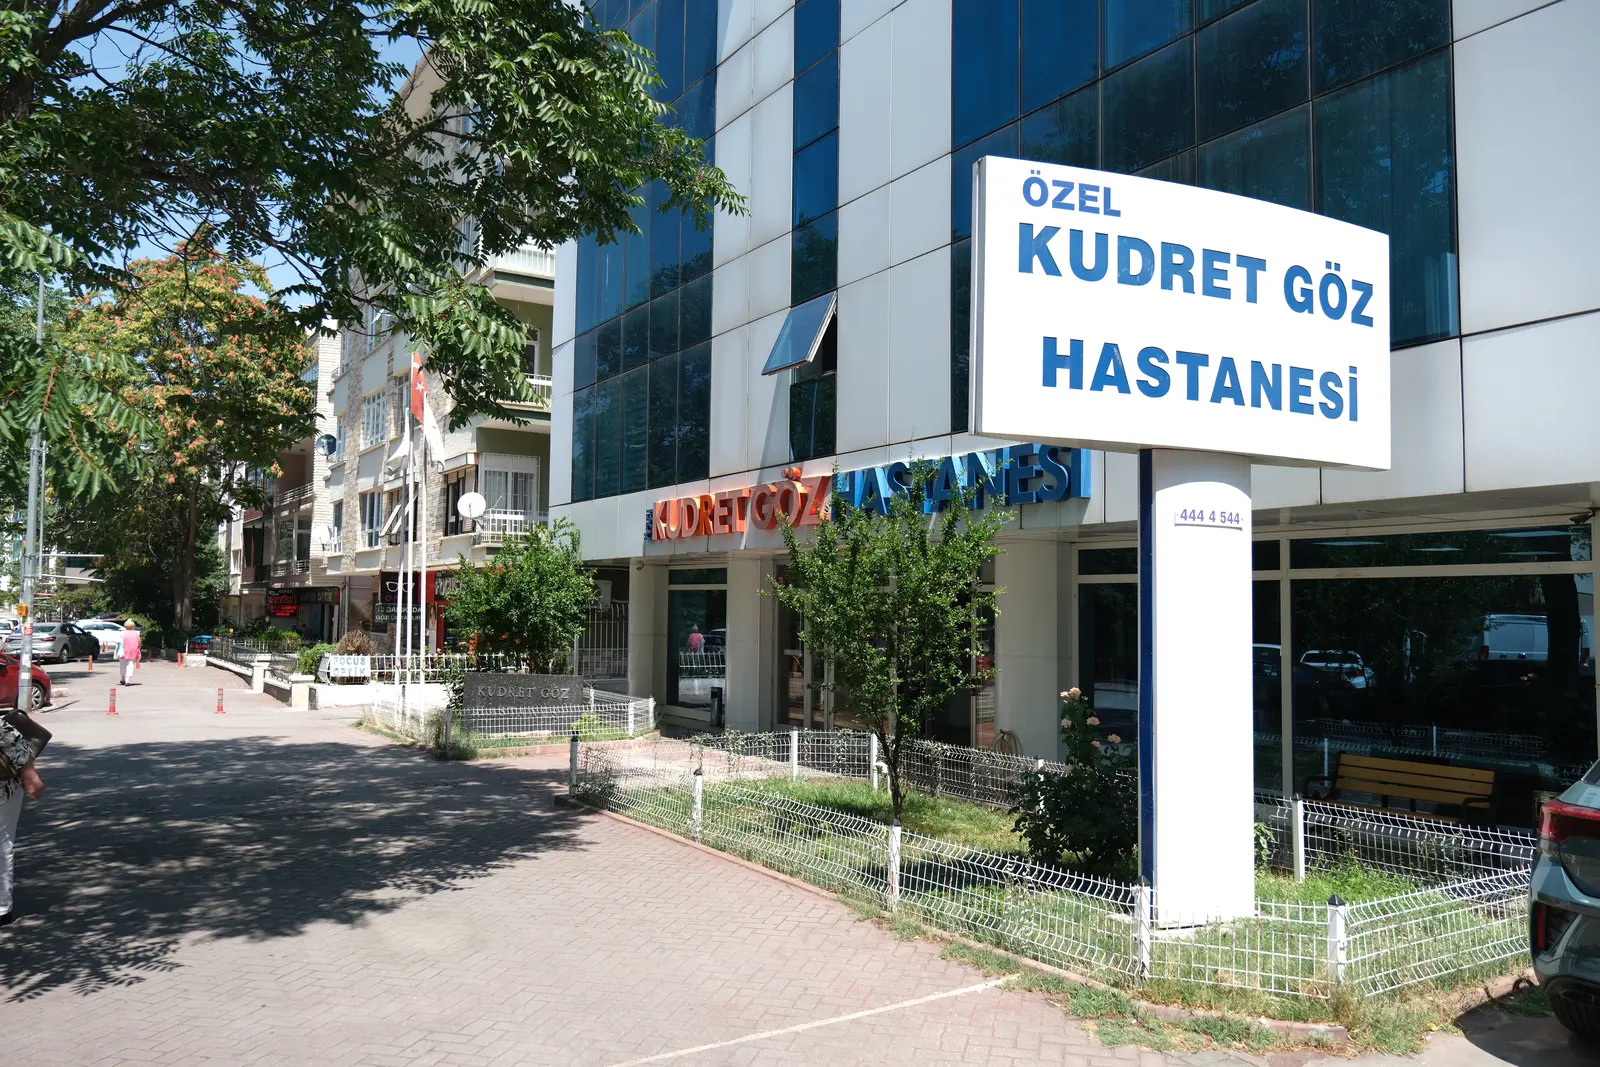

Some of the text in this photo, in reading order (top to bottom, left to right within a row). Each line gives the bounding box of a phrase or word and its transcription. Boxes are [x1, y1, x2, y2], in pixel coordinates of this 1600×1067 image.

[1022, 169, 1121, 217] ÖZEL
[1018, 222, 1374, 328] KUDRET GÖZ
[1041, 336, 1359, 422] HASTANESİ
[651, 489, 749, 541] KUDRET
[750, 467, 831, 530] GÖZ
[1180, 508, 1241, 525] 444 4 544
[333, 656, 366, 665] FOCUS
[477, 684, 570, 699] KUDRET GÖZ
